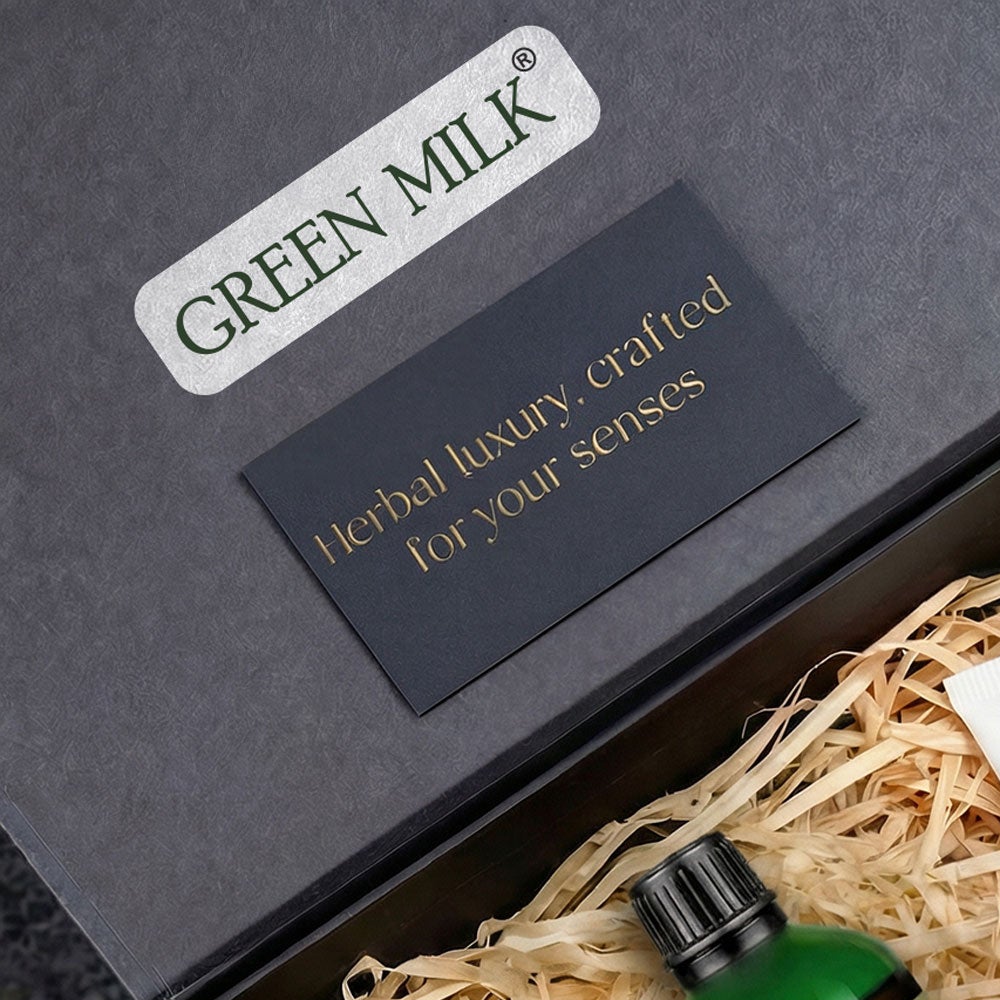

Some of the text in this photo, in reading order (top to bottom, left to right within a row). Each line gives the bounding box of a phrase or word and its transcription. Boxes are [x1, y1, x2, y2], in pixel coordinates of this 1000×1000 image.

[175, 186, 388, 355] GREEN
[313, 458, 448, 565] Herbal
[587, 274, 732, 389] crafted
[405, 370, 706, 573] for your senses
